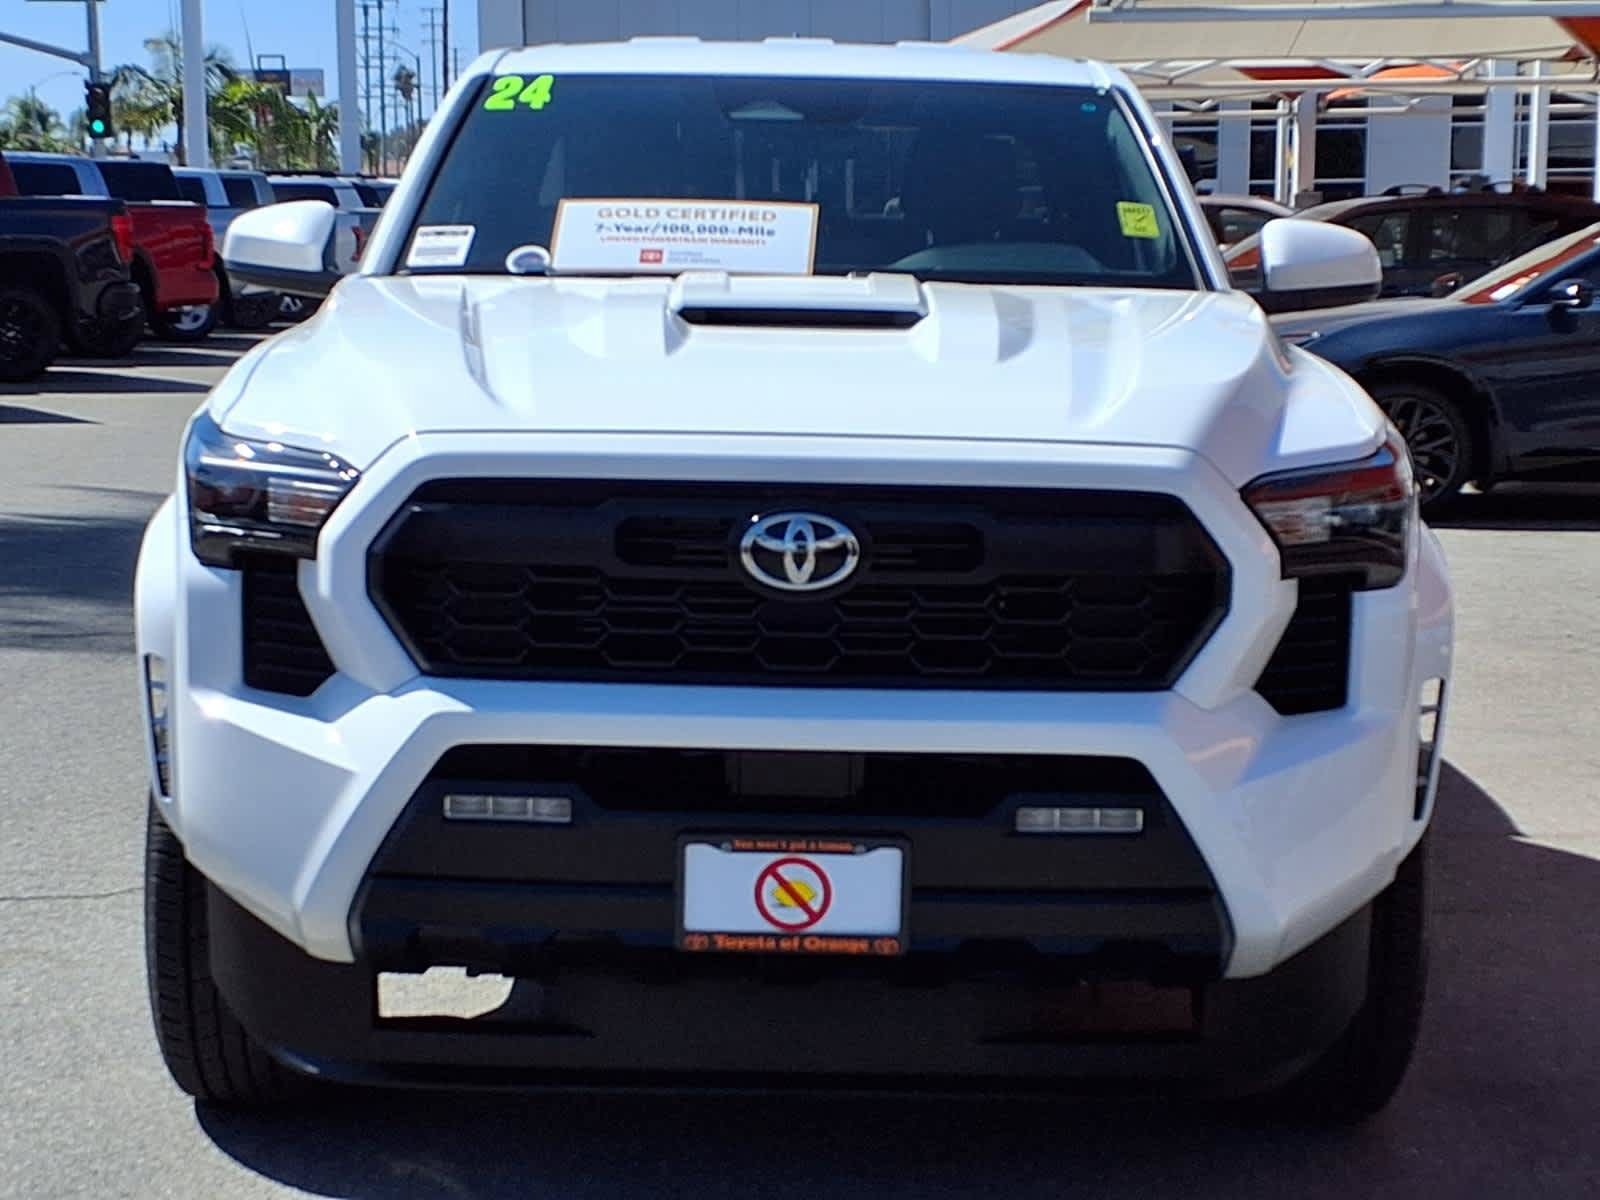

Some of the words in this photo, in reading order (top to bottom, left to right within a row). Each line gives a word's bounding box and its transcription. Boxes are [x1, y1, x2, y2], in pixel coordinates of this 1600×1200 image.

[484, 75, 554, 110] 24
[597, 207, 660, 219] GOLD
[666, 208, 777, 222] CERTIFIED
[714, 934, 776, 950] Toyota
[779, 936, 799, 950] of
[803, 937, 869, 954] Orange
